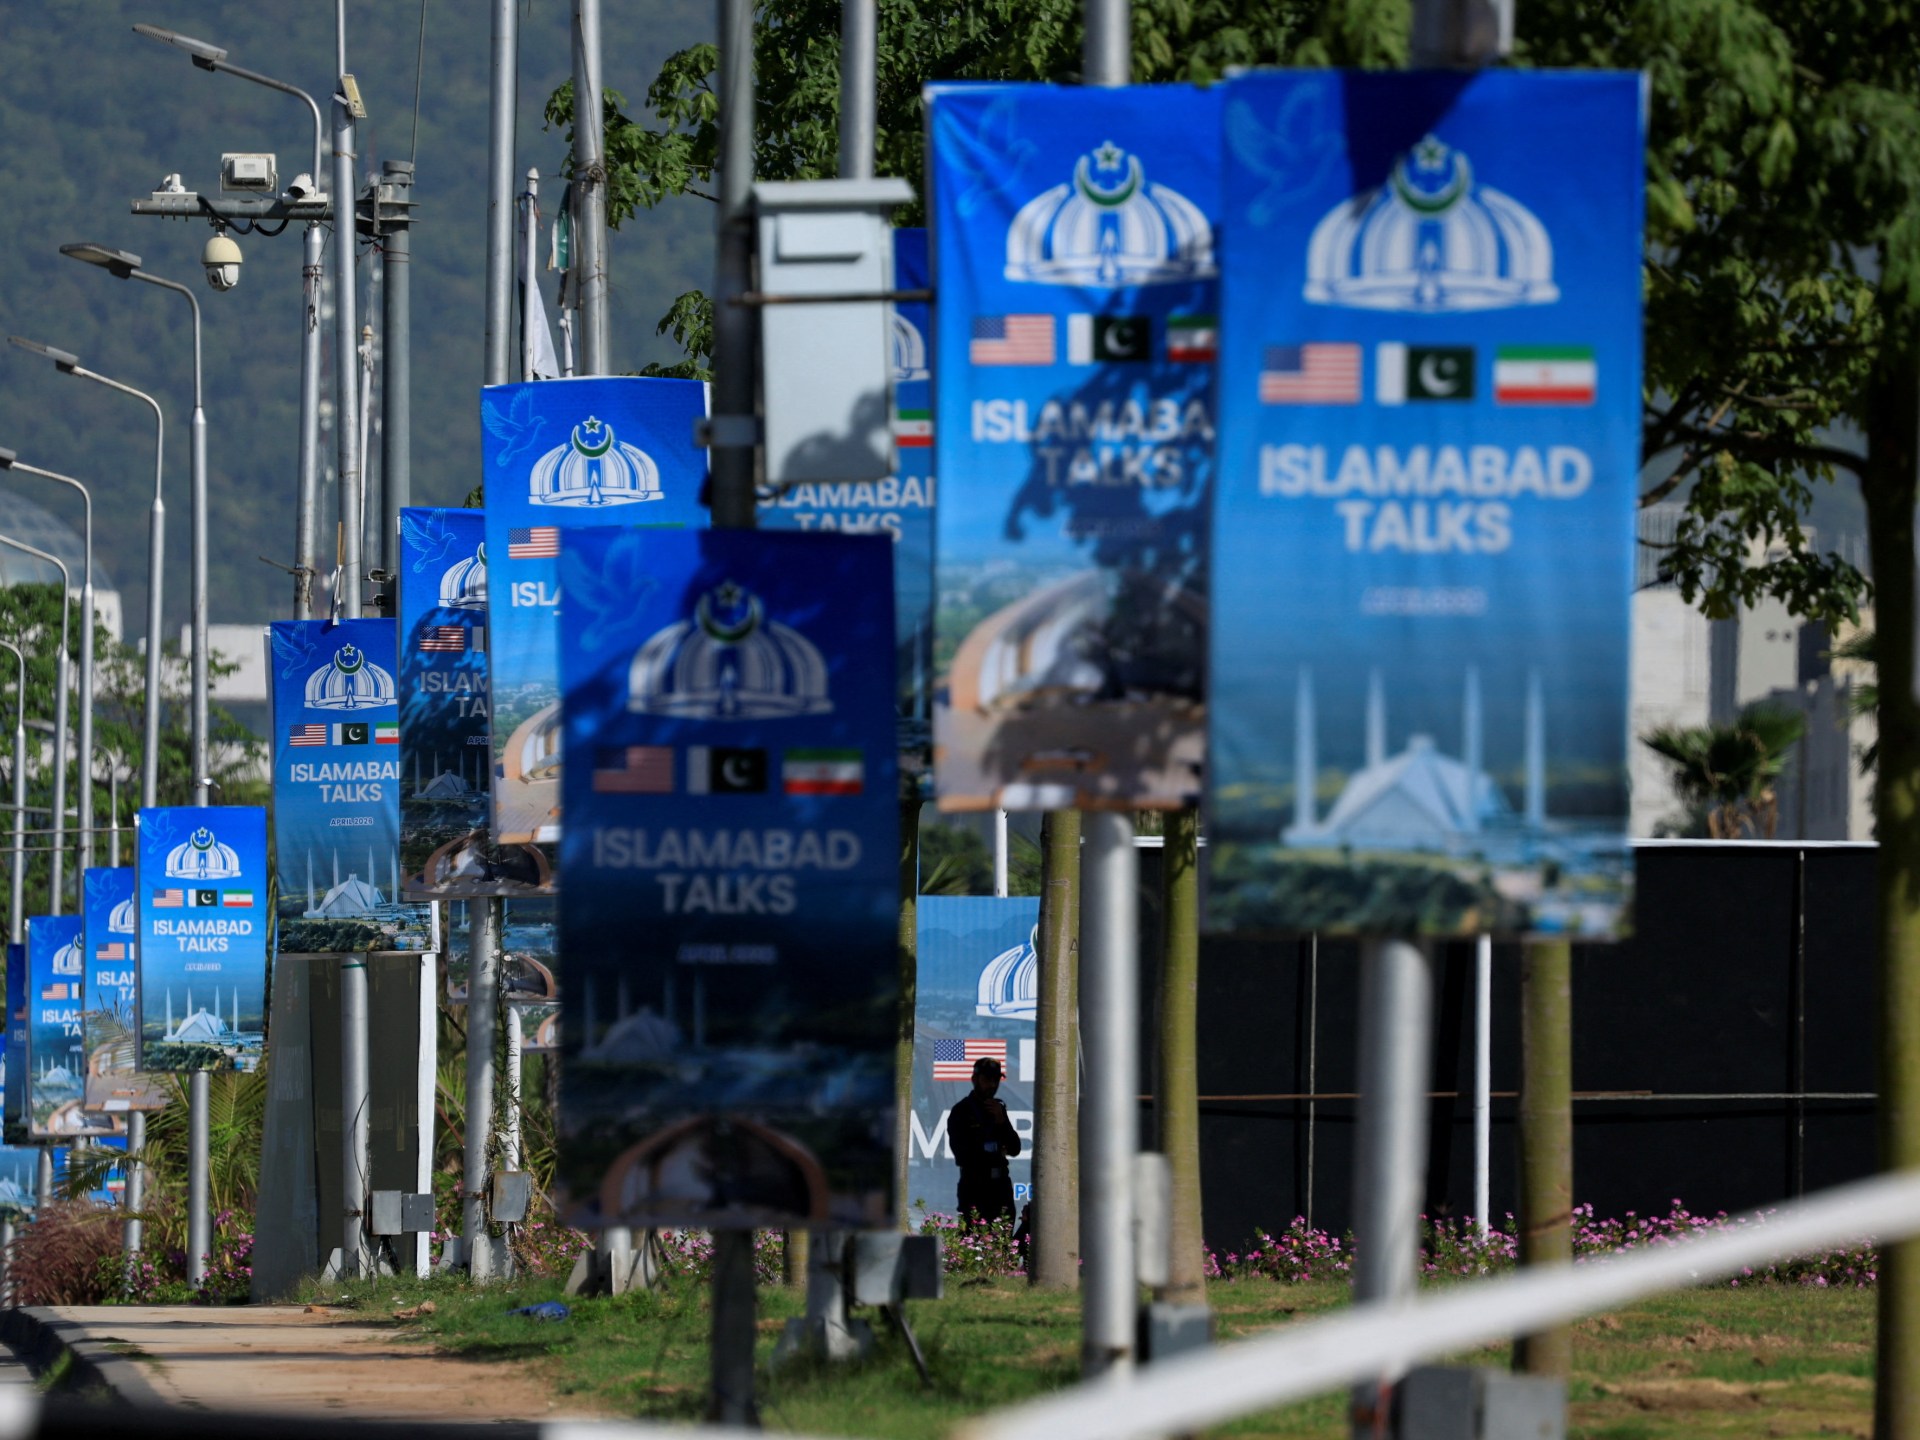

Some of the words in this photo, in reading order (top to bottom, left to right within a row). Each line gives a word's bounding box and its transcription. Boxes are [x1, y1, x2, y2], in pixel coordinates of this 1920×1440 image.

[1038, 445, 1184, 488] TALKS
[1258, 443, 1594, 500] ISLAMABAD
[1334, 499, 1512, 554] TALKS
[319, 783, 383, 804] TALKS
[329, 817, 353, 827] APRIL
[592, 827, 863, 871] ISLAMABAD
[655, 872, 799, 915] TALKS
[153, 919, 253, 936] ISLAMABAD
[176, 936, 230, 953] TALKS
